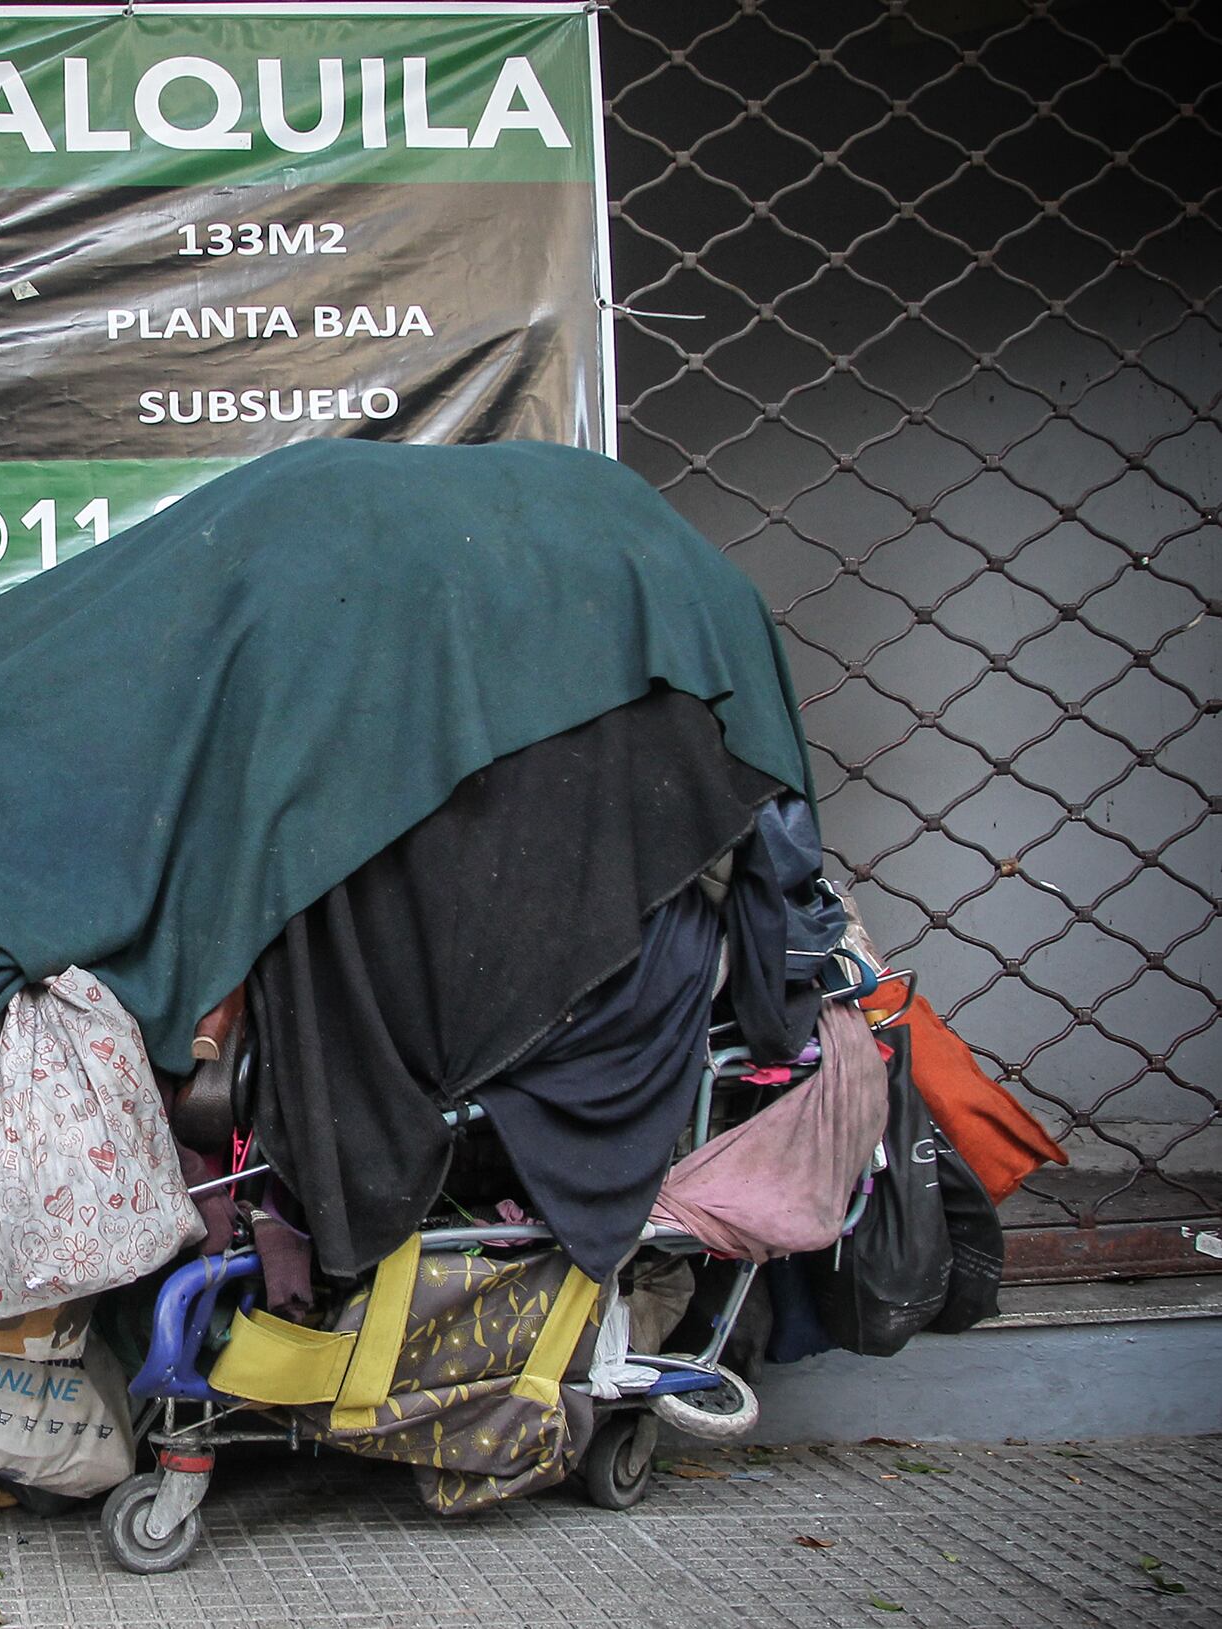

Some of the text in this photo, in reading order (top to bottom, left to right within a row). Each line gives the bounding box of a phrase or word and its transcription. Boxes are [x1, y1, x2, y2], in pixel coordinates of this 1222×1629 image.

[178, 222, 347, 256] 133M2
[108, 305, 434, 340] PLANTA BAJA
[138, 387, 399, 424] SUBSUELO
[71, 1085, 114, 1122] LOE
